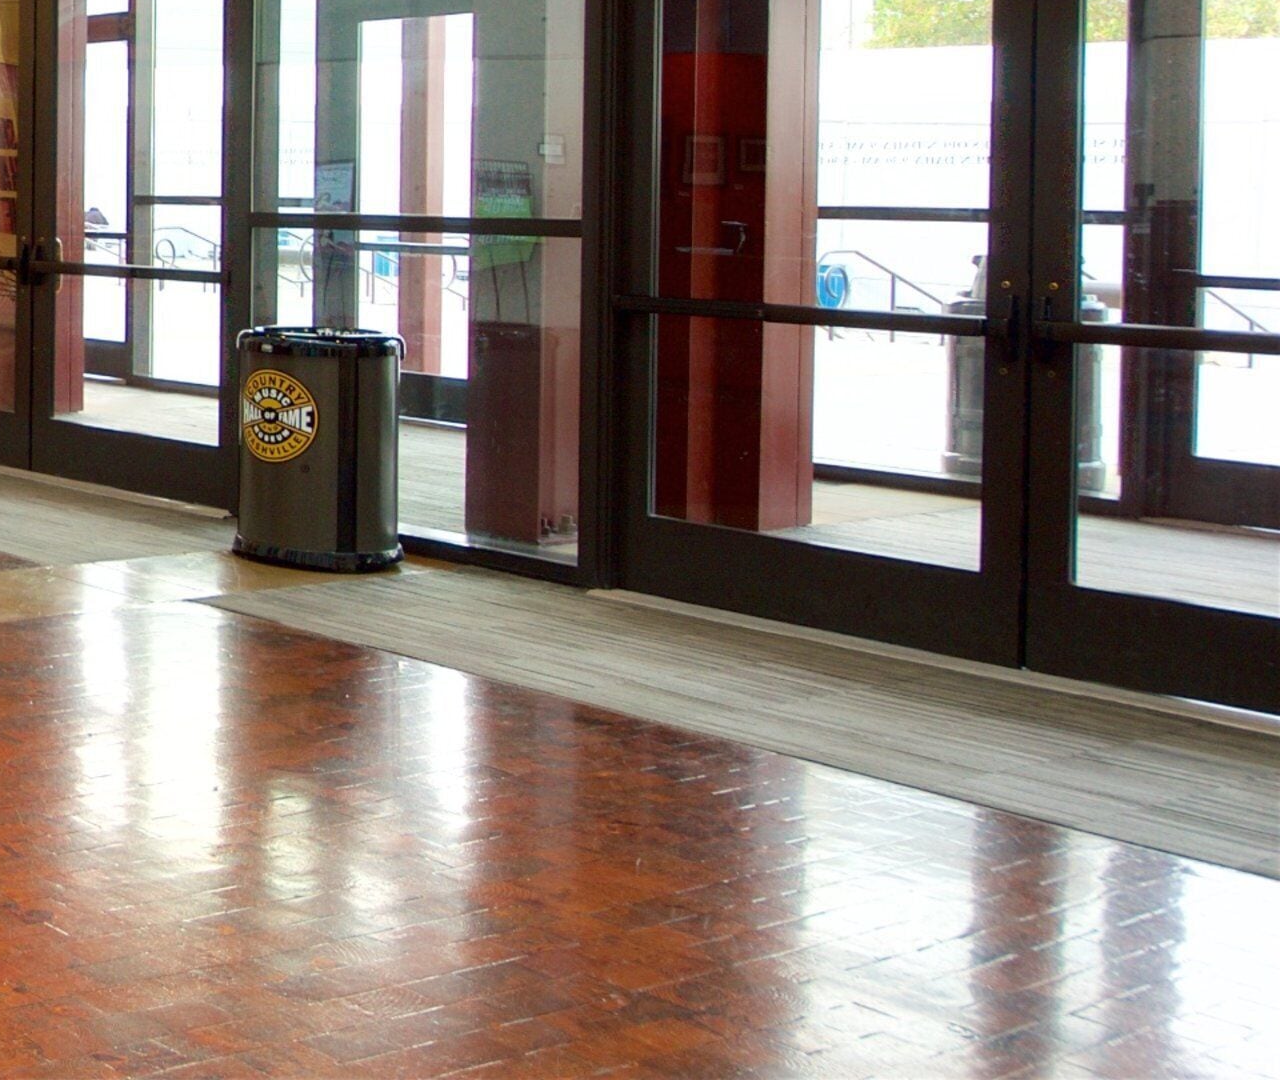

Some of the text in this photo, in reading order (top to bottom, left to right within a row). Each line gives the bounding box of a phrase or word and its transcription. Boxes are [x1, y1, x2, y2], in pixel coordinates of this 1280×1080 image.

[247, 376, 305, 403] COUNTRY
[254, 388, 291, 406] MUSIC
[243, 398, 313, 434] HALL OF FAME
[247, 431, 302, 455] NASHVILLE
